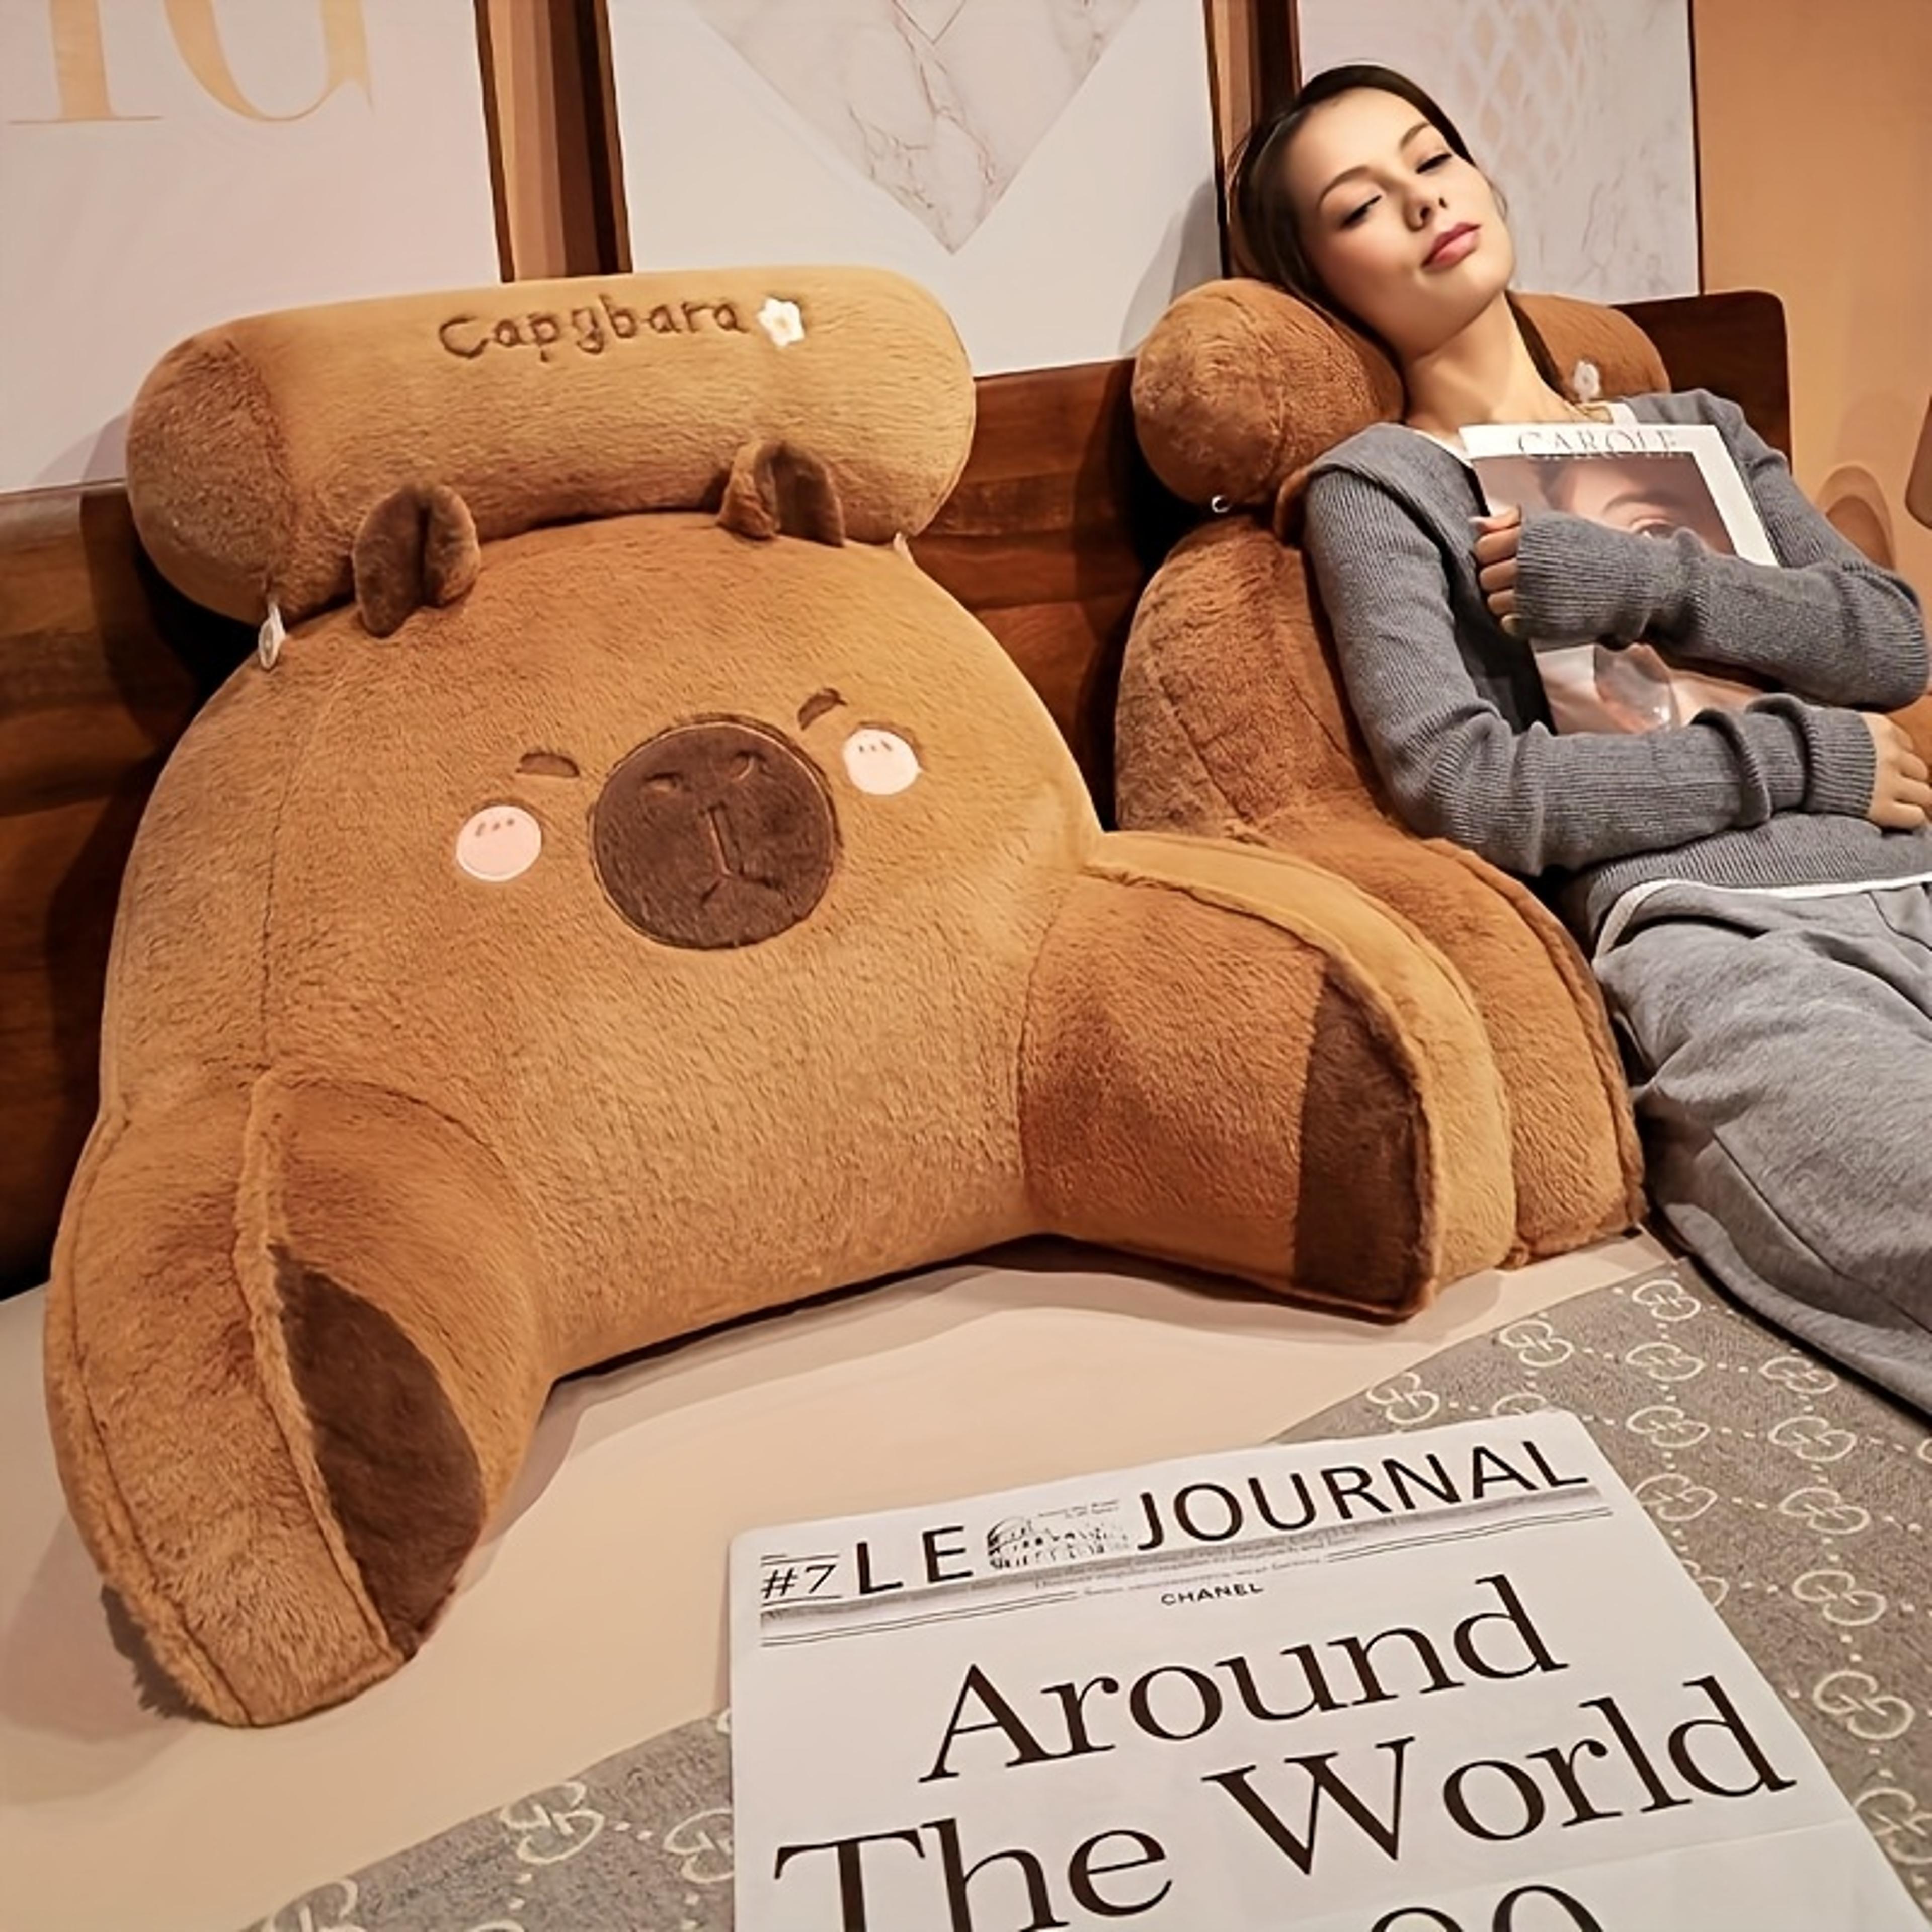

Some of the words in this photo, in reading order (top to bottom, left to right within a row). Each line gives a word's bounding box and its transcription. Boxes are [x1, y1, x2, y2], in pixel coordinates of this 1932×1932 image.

[439, 294, 748, 363] Capybara
[761, 1563, 837, 1599] #7
[856, 1526, 974, 1595] LE
[1137, 1440, 1588, 1551] JOURNAL
[1160, 1583, 1265, 1606] CHANEL
[918, 1574, 1569, 1783] Around
[774, 1817, 1173, 1932] The
[1200, 1675, 1797, 1876] World
